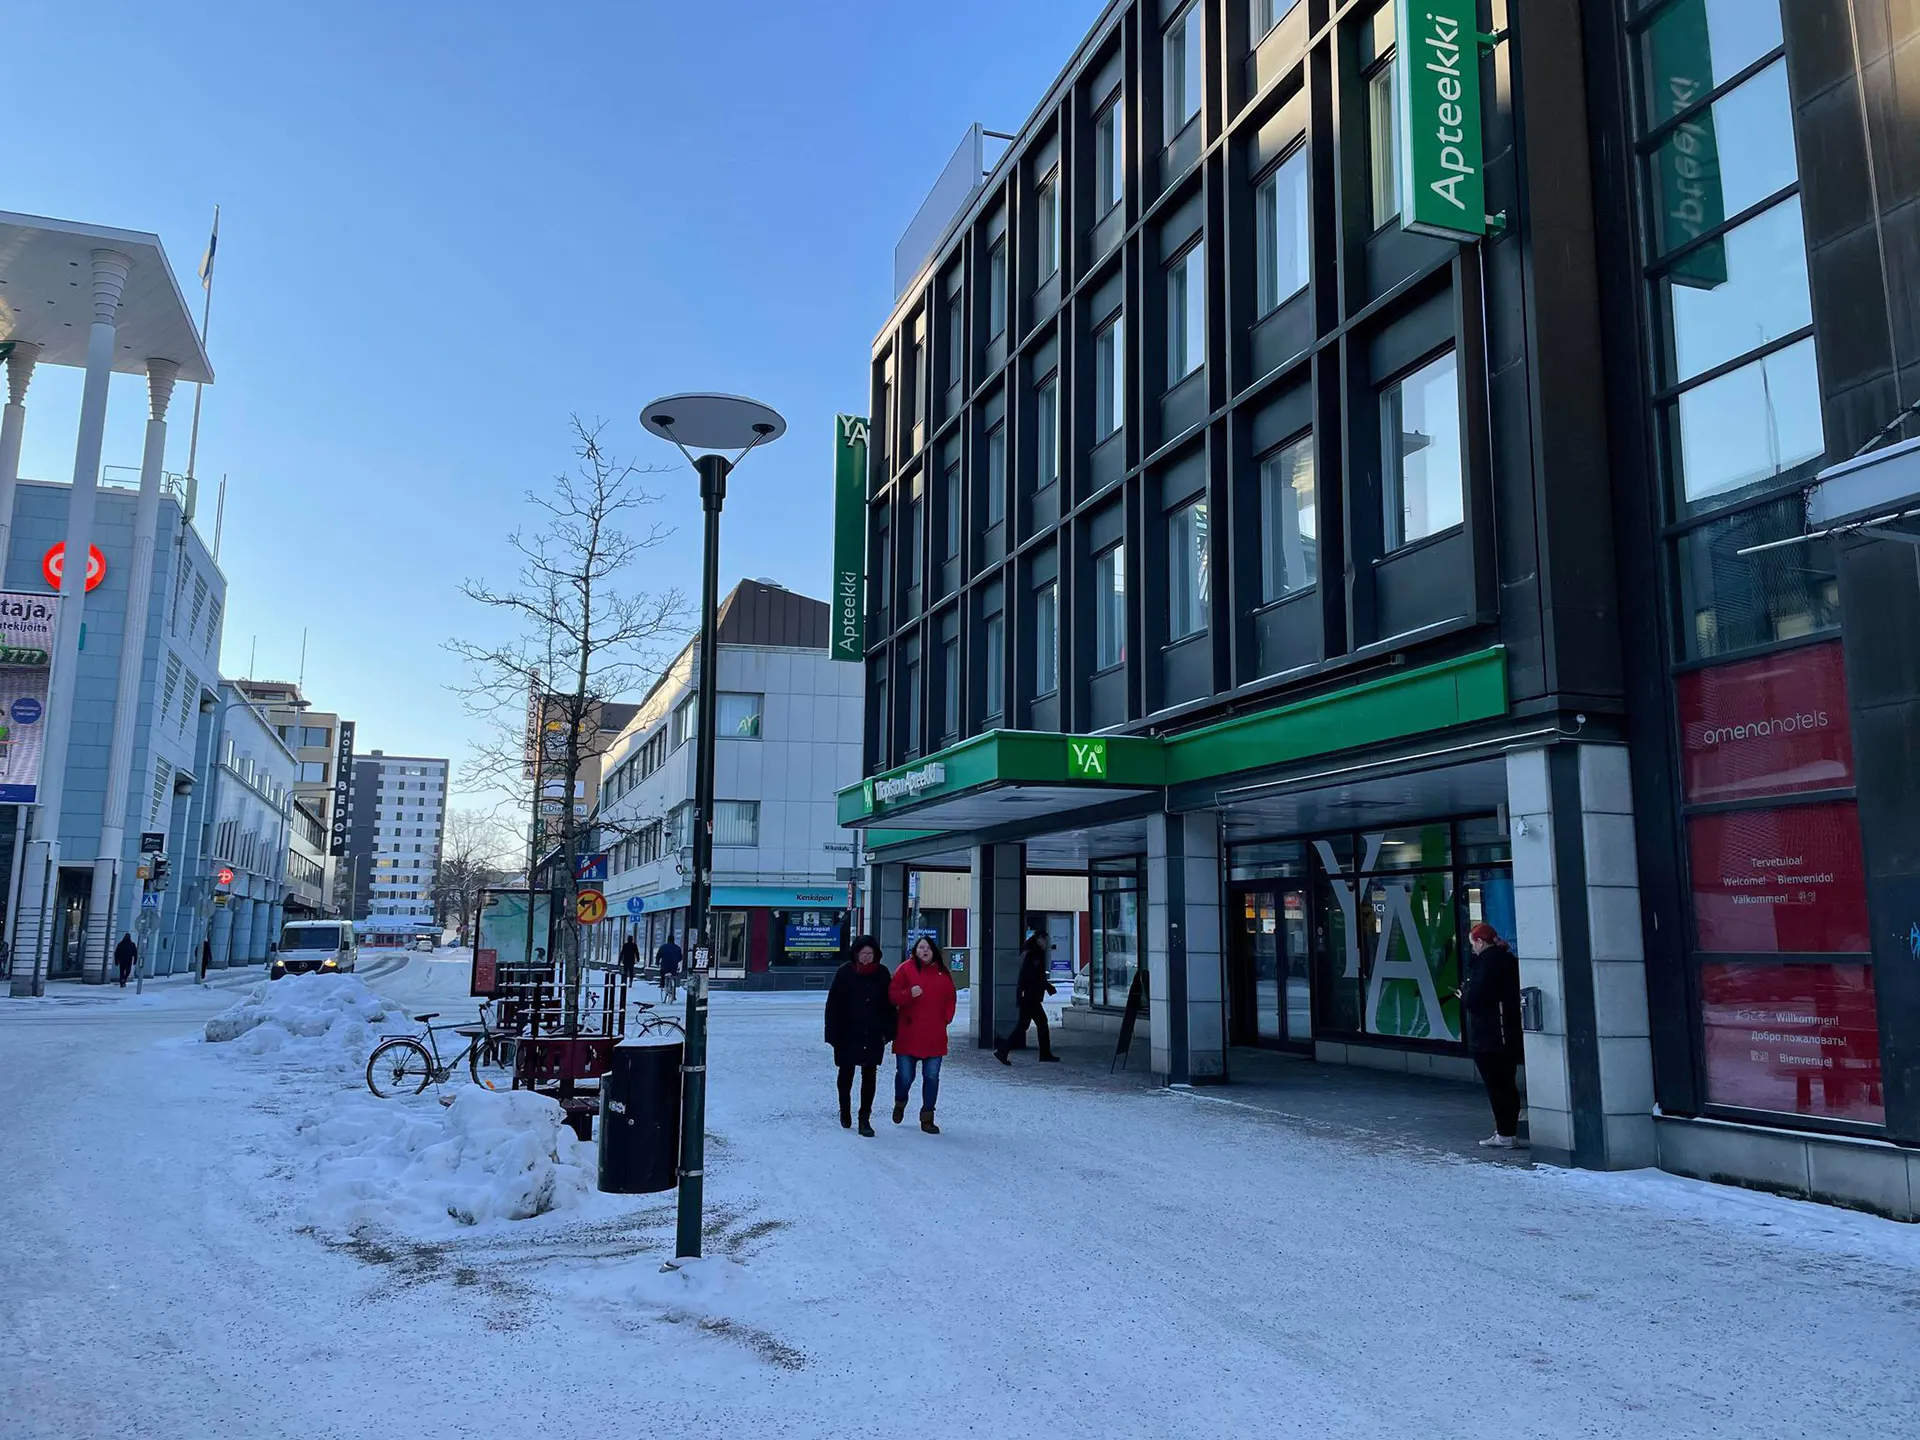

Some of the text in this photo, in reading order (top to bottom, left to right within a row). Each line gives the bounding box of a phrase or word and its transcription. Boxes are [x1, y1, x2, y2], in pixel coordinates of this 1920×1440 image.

[1425, 13, 1474, 210] Apteekki
[837, 412, 869, 448] YA
[838, 571, 860, 652] Apteekki
[1703, 711, 1828, 744] omenahotels
[1072, 744, 1103, 773] YA
[333, 731, 351, 846] HOTEL BEPOP
[1751, 856, 1803, 868] Tervetuloa!
[1723, 873, 1834, 886] Welcome! Bienvenido!
[1732, 894, 1788, 905] Välkommen!
[1312, 833, 1460, 1041] YA
[1735, 1009, 1767, 1021] ようこそ
[1776, 1012, 1839, 1025] Willkommen!
[1751, 1031, 1847, 1046] Добро пожаловать!
[1779, 1053, 1833, 1067] Bienvenue!
